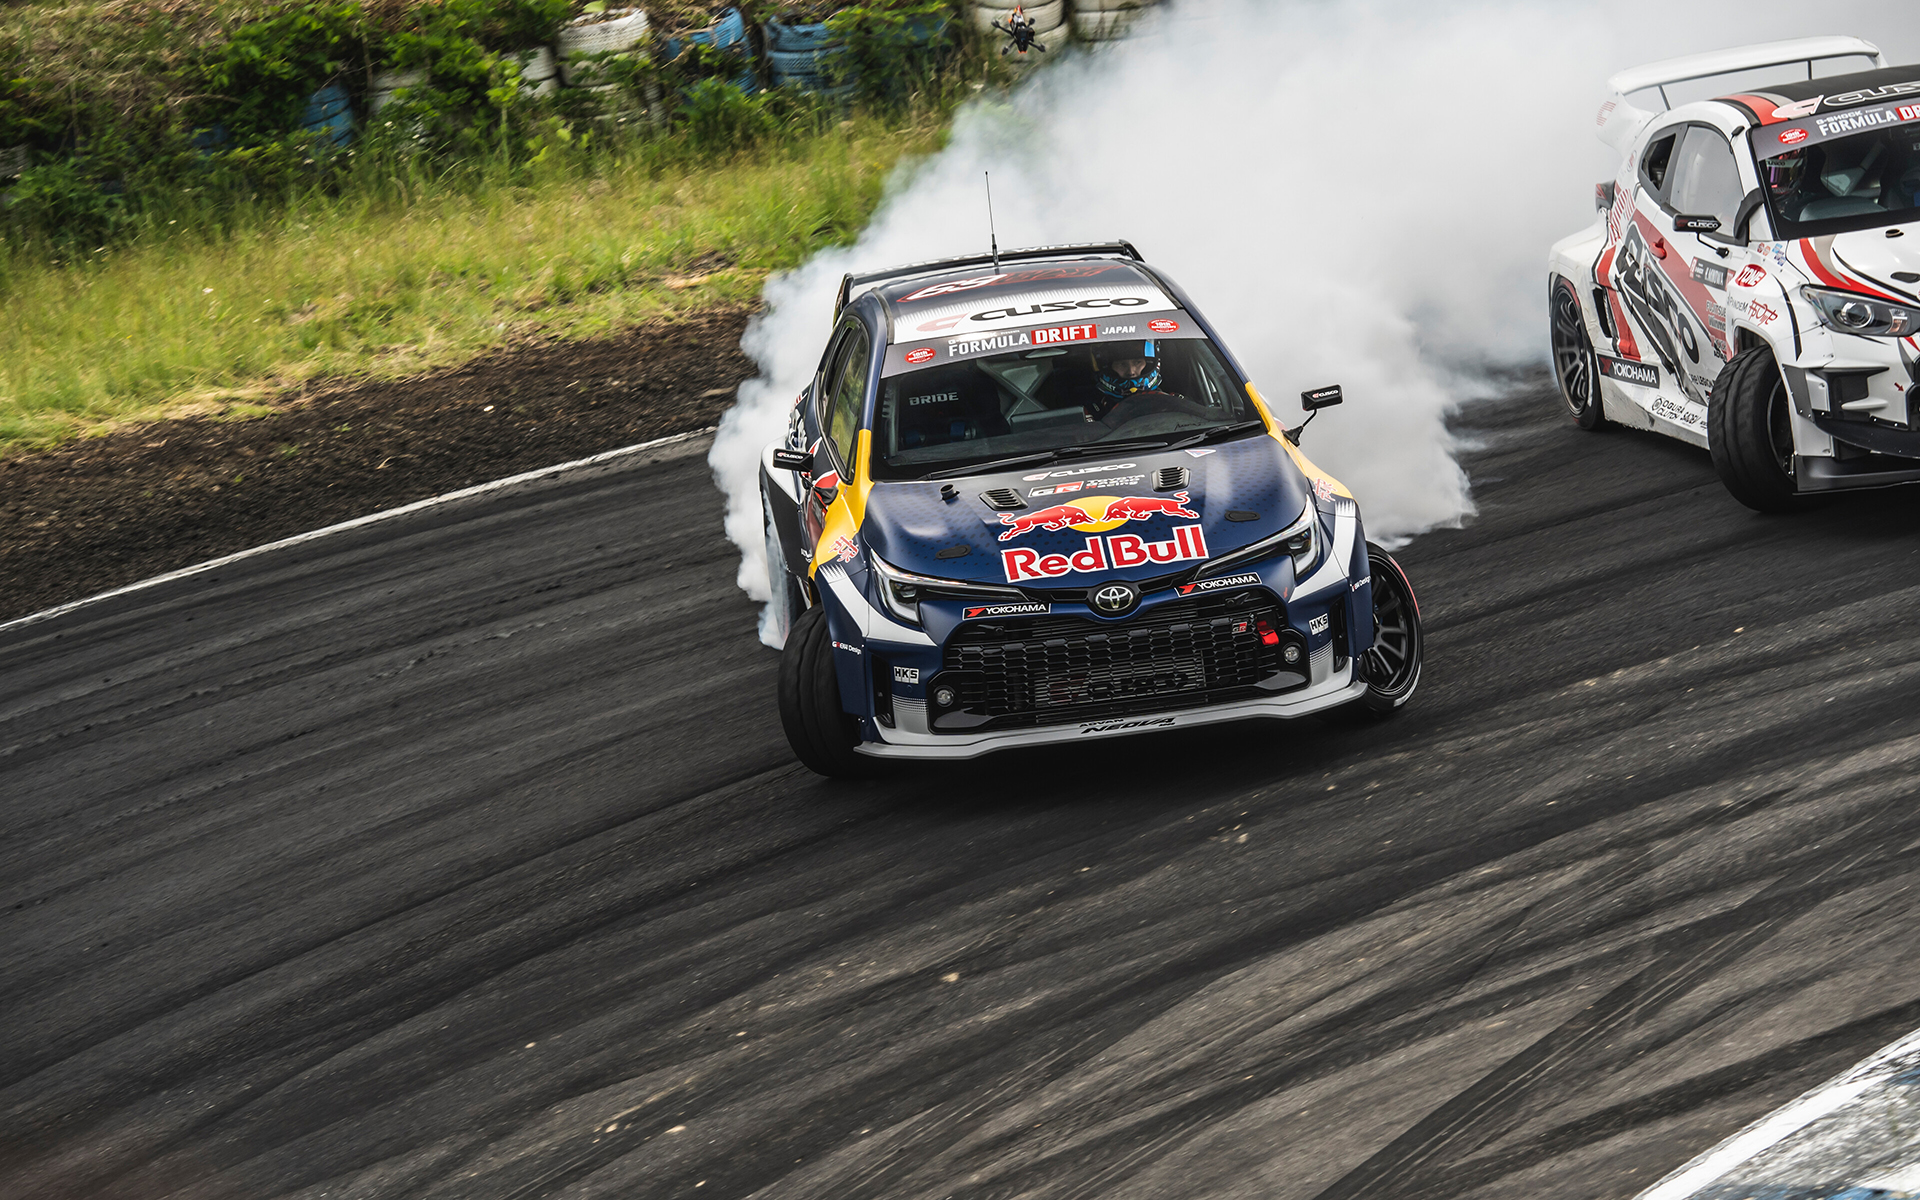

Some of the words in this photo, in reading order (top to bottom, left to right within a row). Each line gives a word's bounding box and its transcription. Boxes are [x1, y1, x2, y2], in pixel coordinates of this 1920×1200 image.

[1818, 110, 1898, 137] FORMULA
[1687, 221, 1719, 229] CUSCO
[969, 297, 1149, 321] CUSCO
[948, 333, 1030, 357] FORMULA
[1035, 325, 1093, 344] DRIFT
[1102, 325, 1136, 335] JAPAN
[1612, 361, 1657, 384] YOKOHAMA
[909, 391, 959, 406] BRIDE
[1049, 463, 1137, 478] CUSCO
[1031, 484, 1080, 497] GR
[1001, 537, 1108, 583] Red
[1107, 525, 1208, 569] Bull
[1197, 574, 1257, 590] YOKOHAMA
[985, 603, 1047, 615] YOKOHAMA
[1310, 614, 1328, 630] HKS
[894, 667, 918, 679] HKS
[1078, 718, 1125, 728] ADVAN
[1081, 717, 1176, 734] NEOVA
